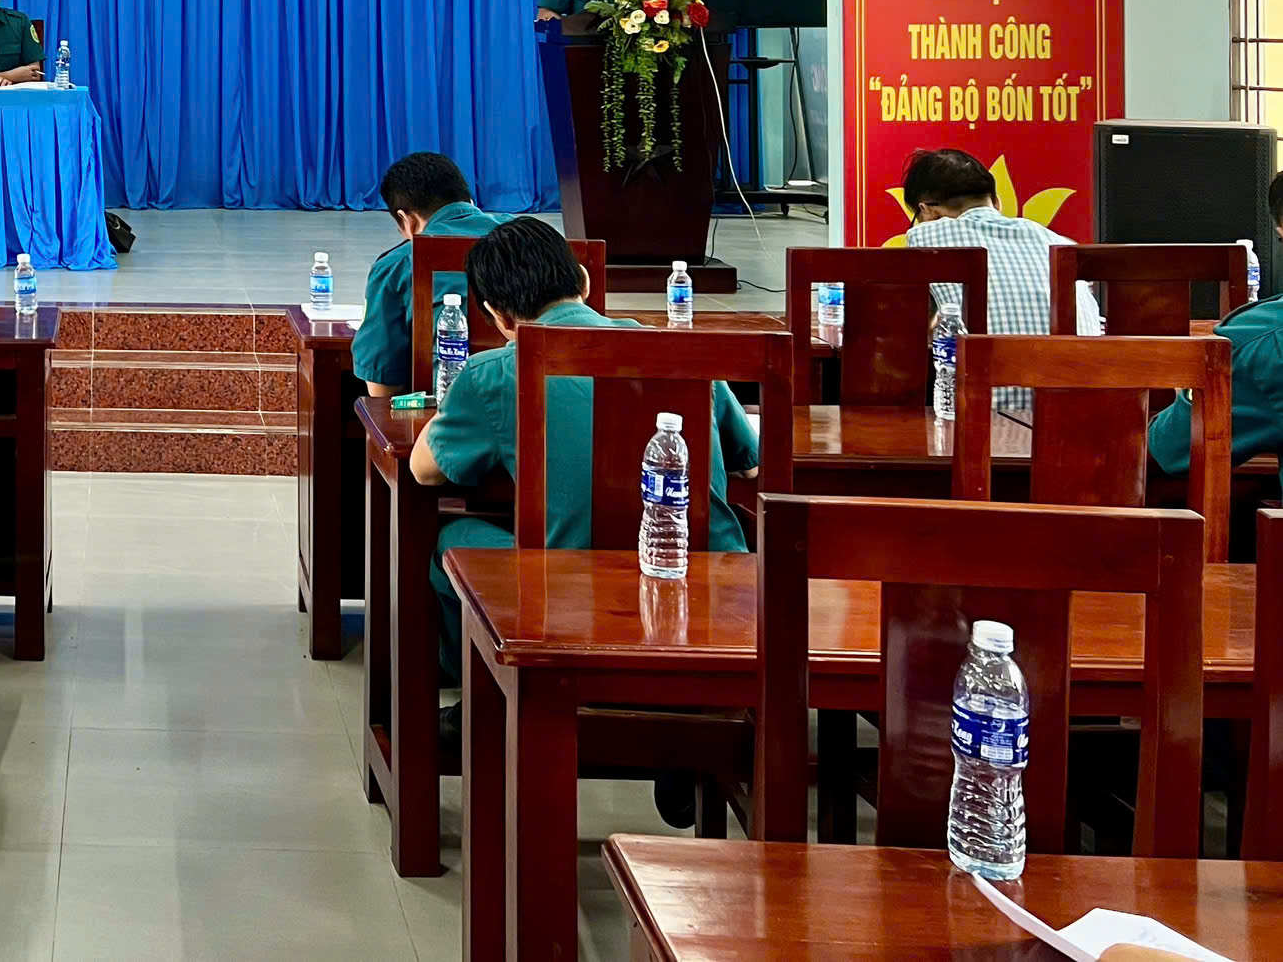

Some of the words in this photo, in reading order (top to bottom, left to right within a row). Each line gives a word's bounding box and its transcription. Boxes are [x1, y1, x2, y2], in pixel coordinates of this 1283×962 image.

[909, 16, 982, 59] THÀNH
[989, 16, 1051, 59] CÔNG
[950, 79, 979, 129] BỘ
[987, 73, 1032, 121] BỐN
